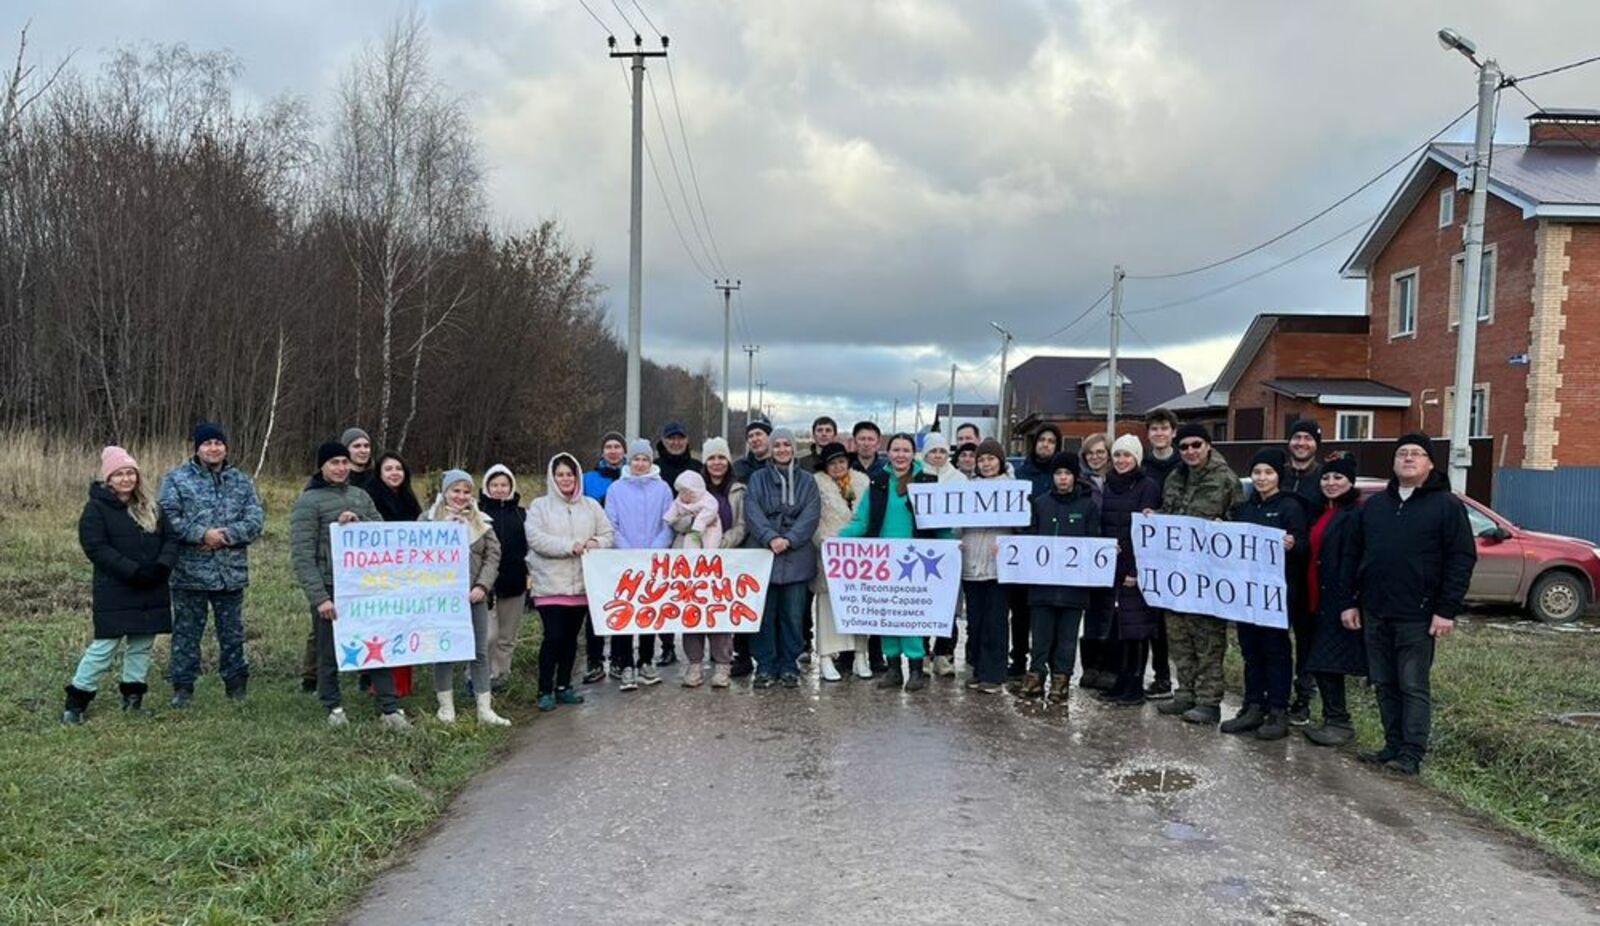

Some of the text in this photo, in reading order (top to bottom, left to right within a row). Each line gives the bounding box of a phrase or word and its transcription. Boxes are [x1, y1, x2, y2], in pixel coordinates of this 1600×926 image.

[914, 490, 1026, 515] ППМИ
[343, 529, 461, 548] ПРОГРАММА
[1140, 524, 1279, 566] РЕМОНТ
[343, 549, 460, 568] ПОДДЕРЖКИ
[827, 542, 890, 558] ППМИ
[1006, 544, 1108, 568] 2026
[651, 553, 723, 579] НАМ
[828, 558, 890, 581] 2026
[360, 570, 457, 590] МЕСТ
[614, 568, 760, 604] НУЖНА
[860, 582, 928, 594] Лесопарковая
[1142, 568, 1283, 612] ДОРОГИ
[350, 598, 462, 617] ИНИЦИАТИВ
[846, 605, 859, 615] ГО
[861, 594, 934, 606] Крым-Сараево
[881, 619, 949, 630] Башкортостан
[392, 631, 450, 655] 206
